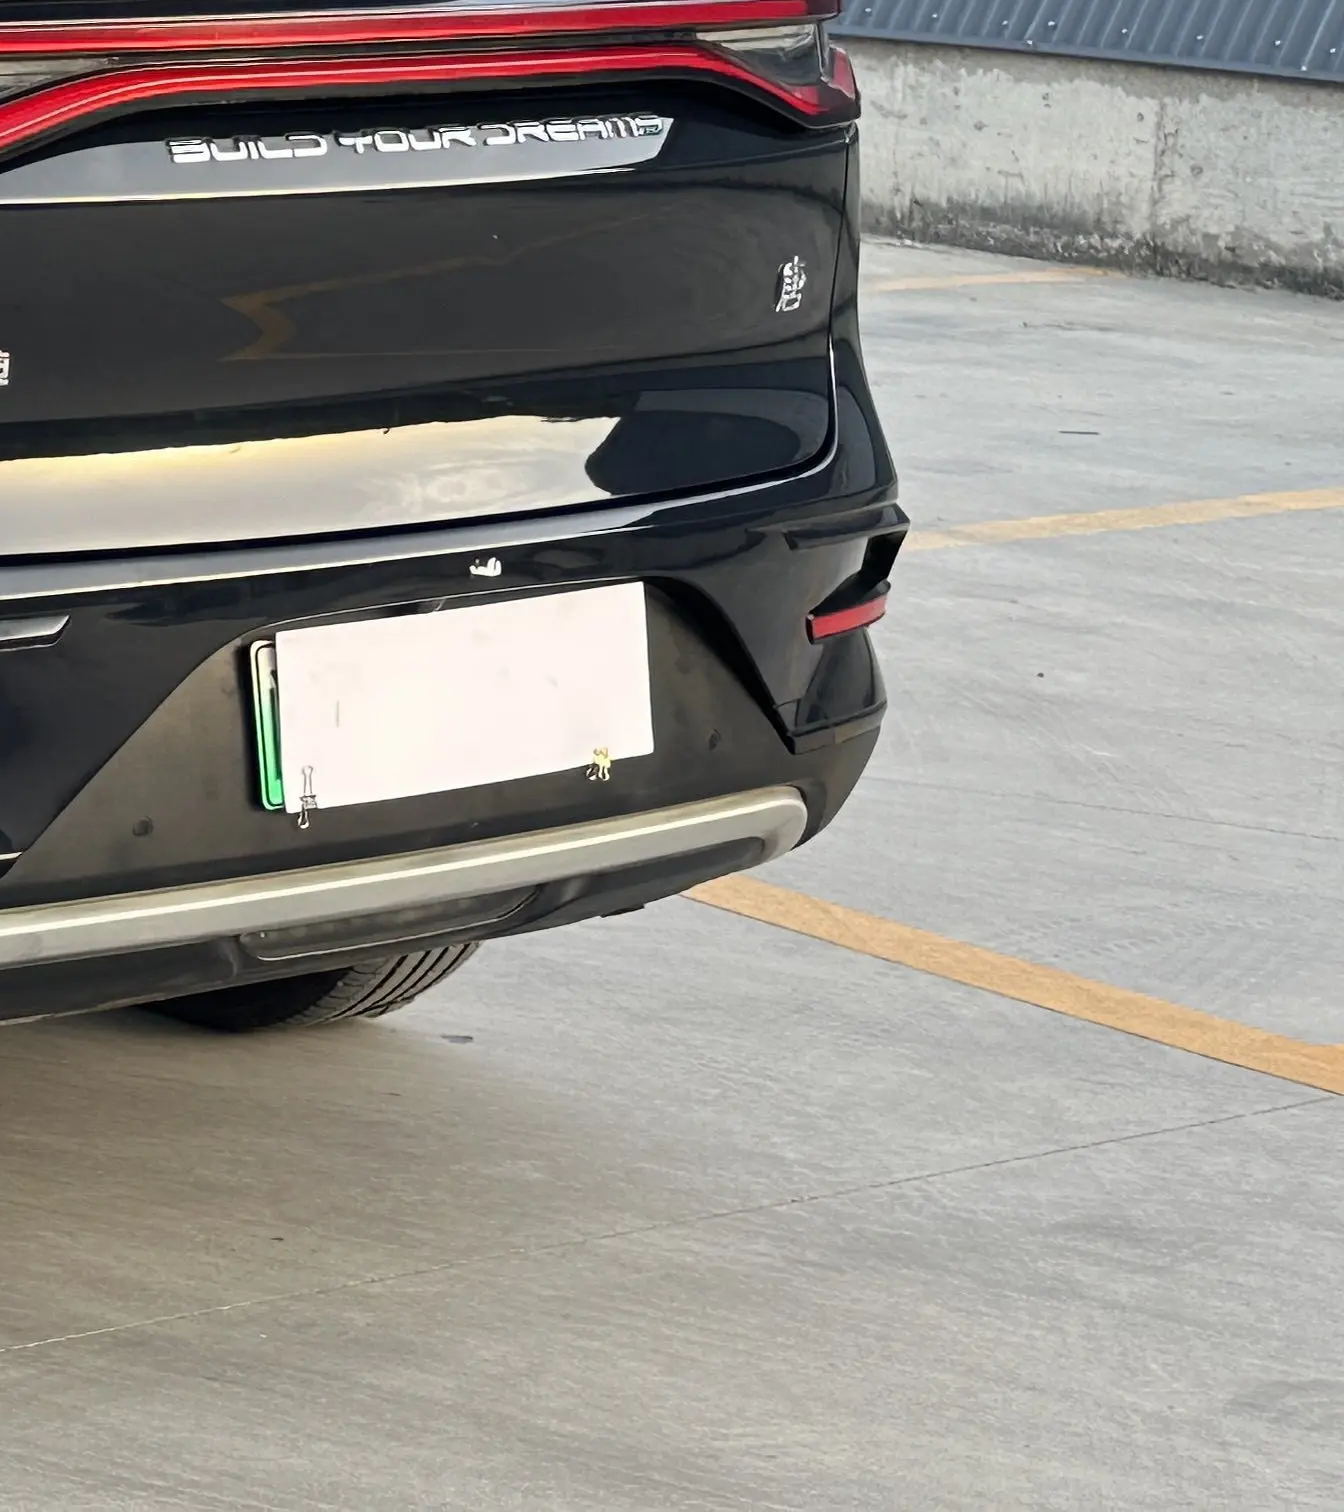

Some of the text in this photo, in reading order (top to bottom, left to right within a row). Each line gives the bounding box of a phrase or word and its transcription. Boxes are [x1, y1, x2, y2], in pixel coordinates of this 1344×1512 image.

[167, 113, 663, 164] BUILD YOUR DREAMS
